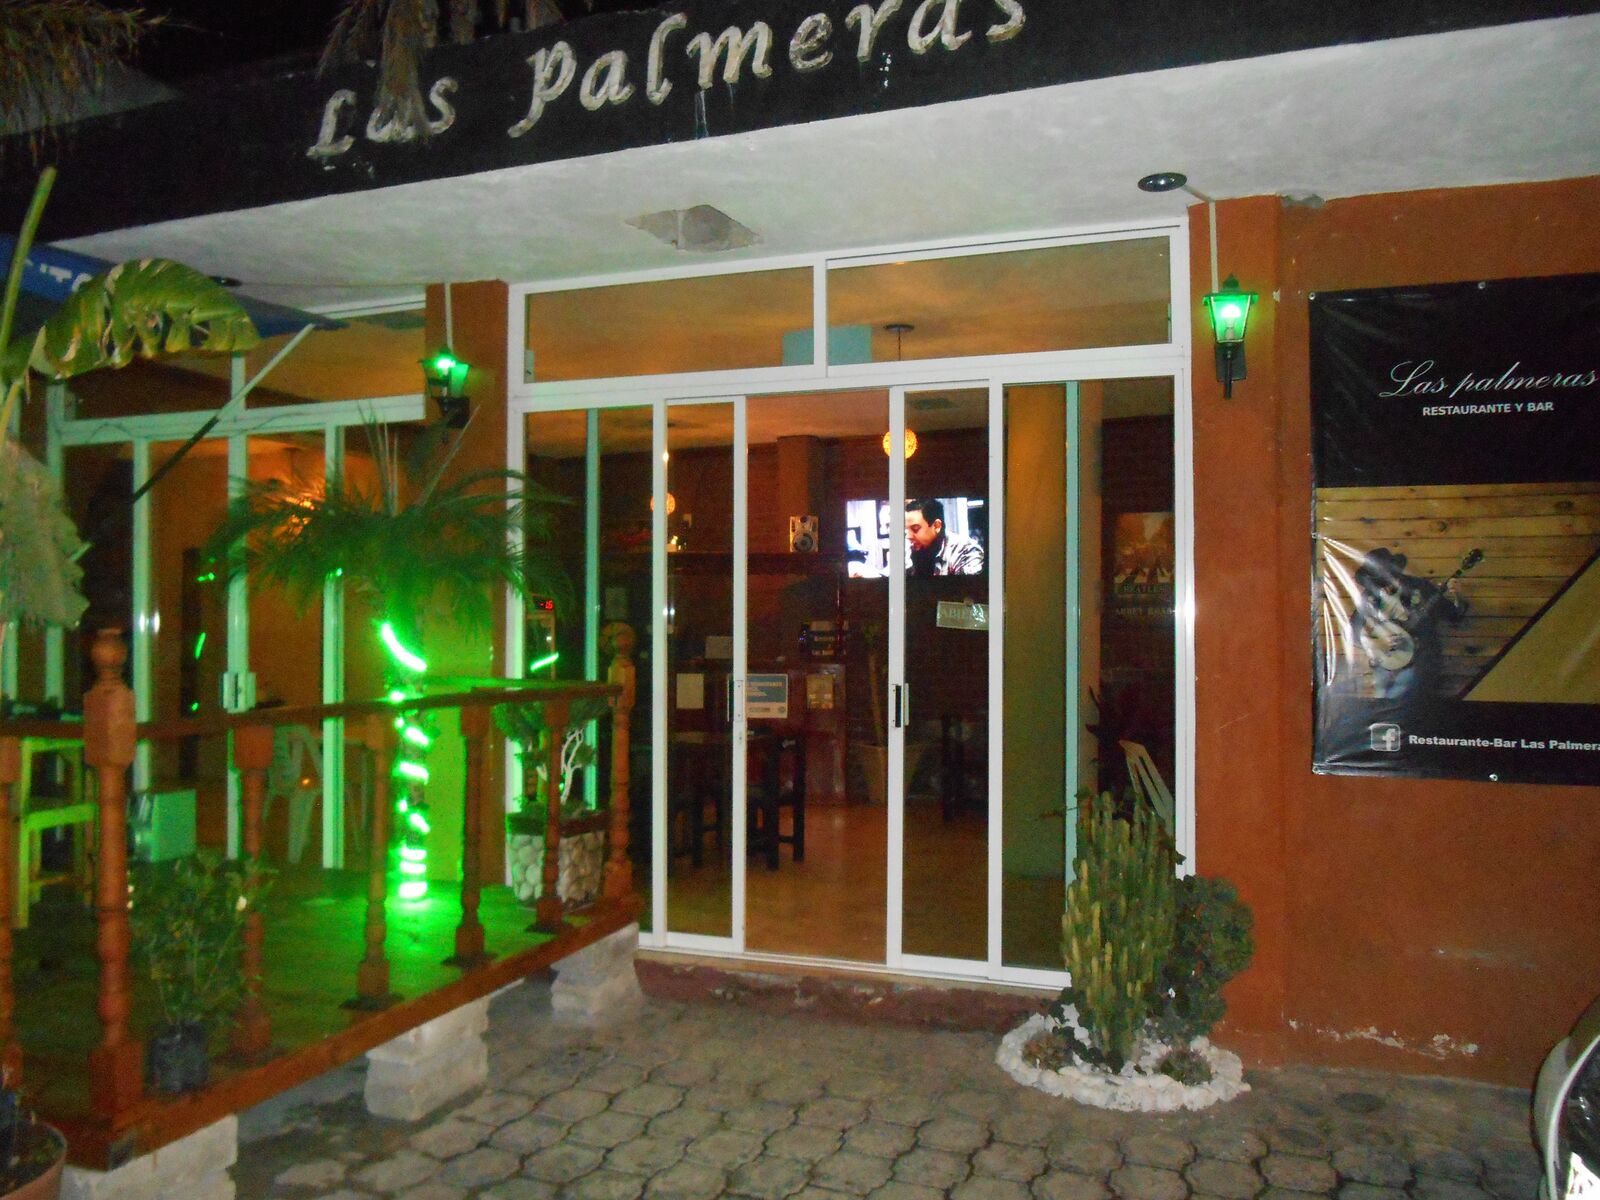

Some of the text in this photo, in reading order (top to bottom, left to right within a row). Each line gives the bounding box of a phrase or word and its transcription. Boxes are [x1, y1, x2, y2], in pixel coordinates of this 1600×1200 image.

[305, 76, 458, 159] Las
[1379, 360, 1599, 398] Las palmeras
[1422, 401, 1554, 416] RESTAURANTE Y BAR
[1408, 734, 1517, 749] Restaurante-Bar
[1520, 739, 1545, 749] Las
